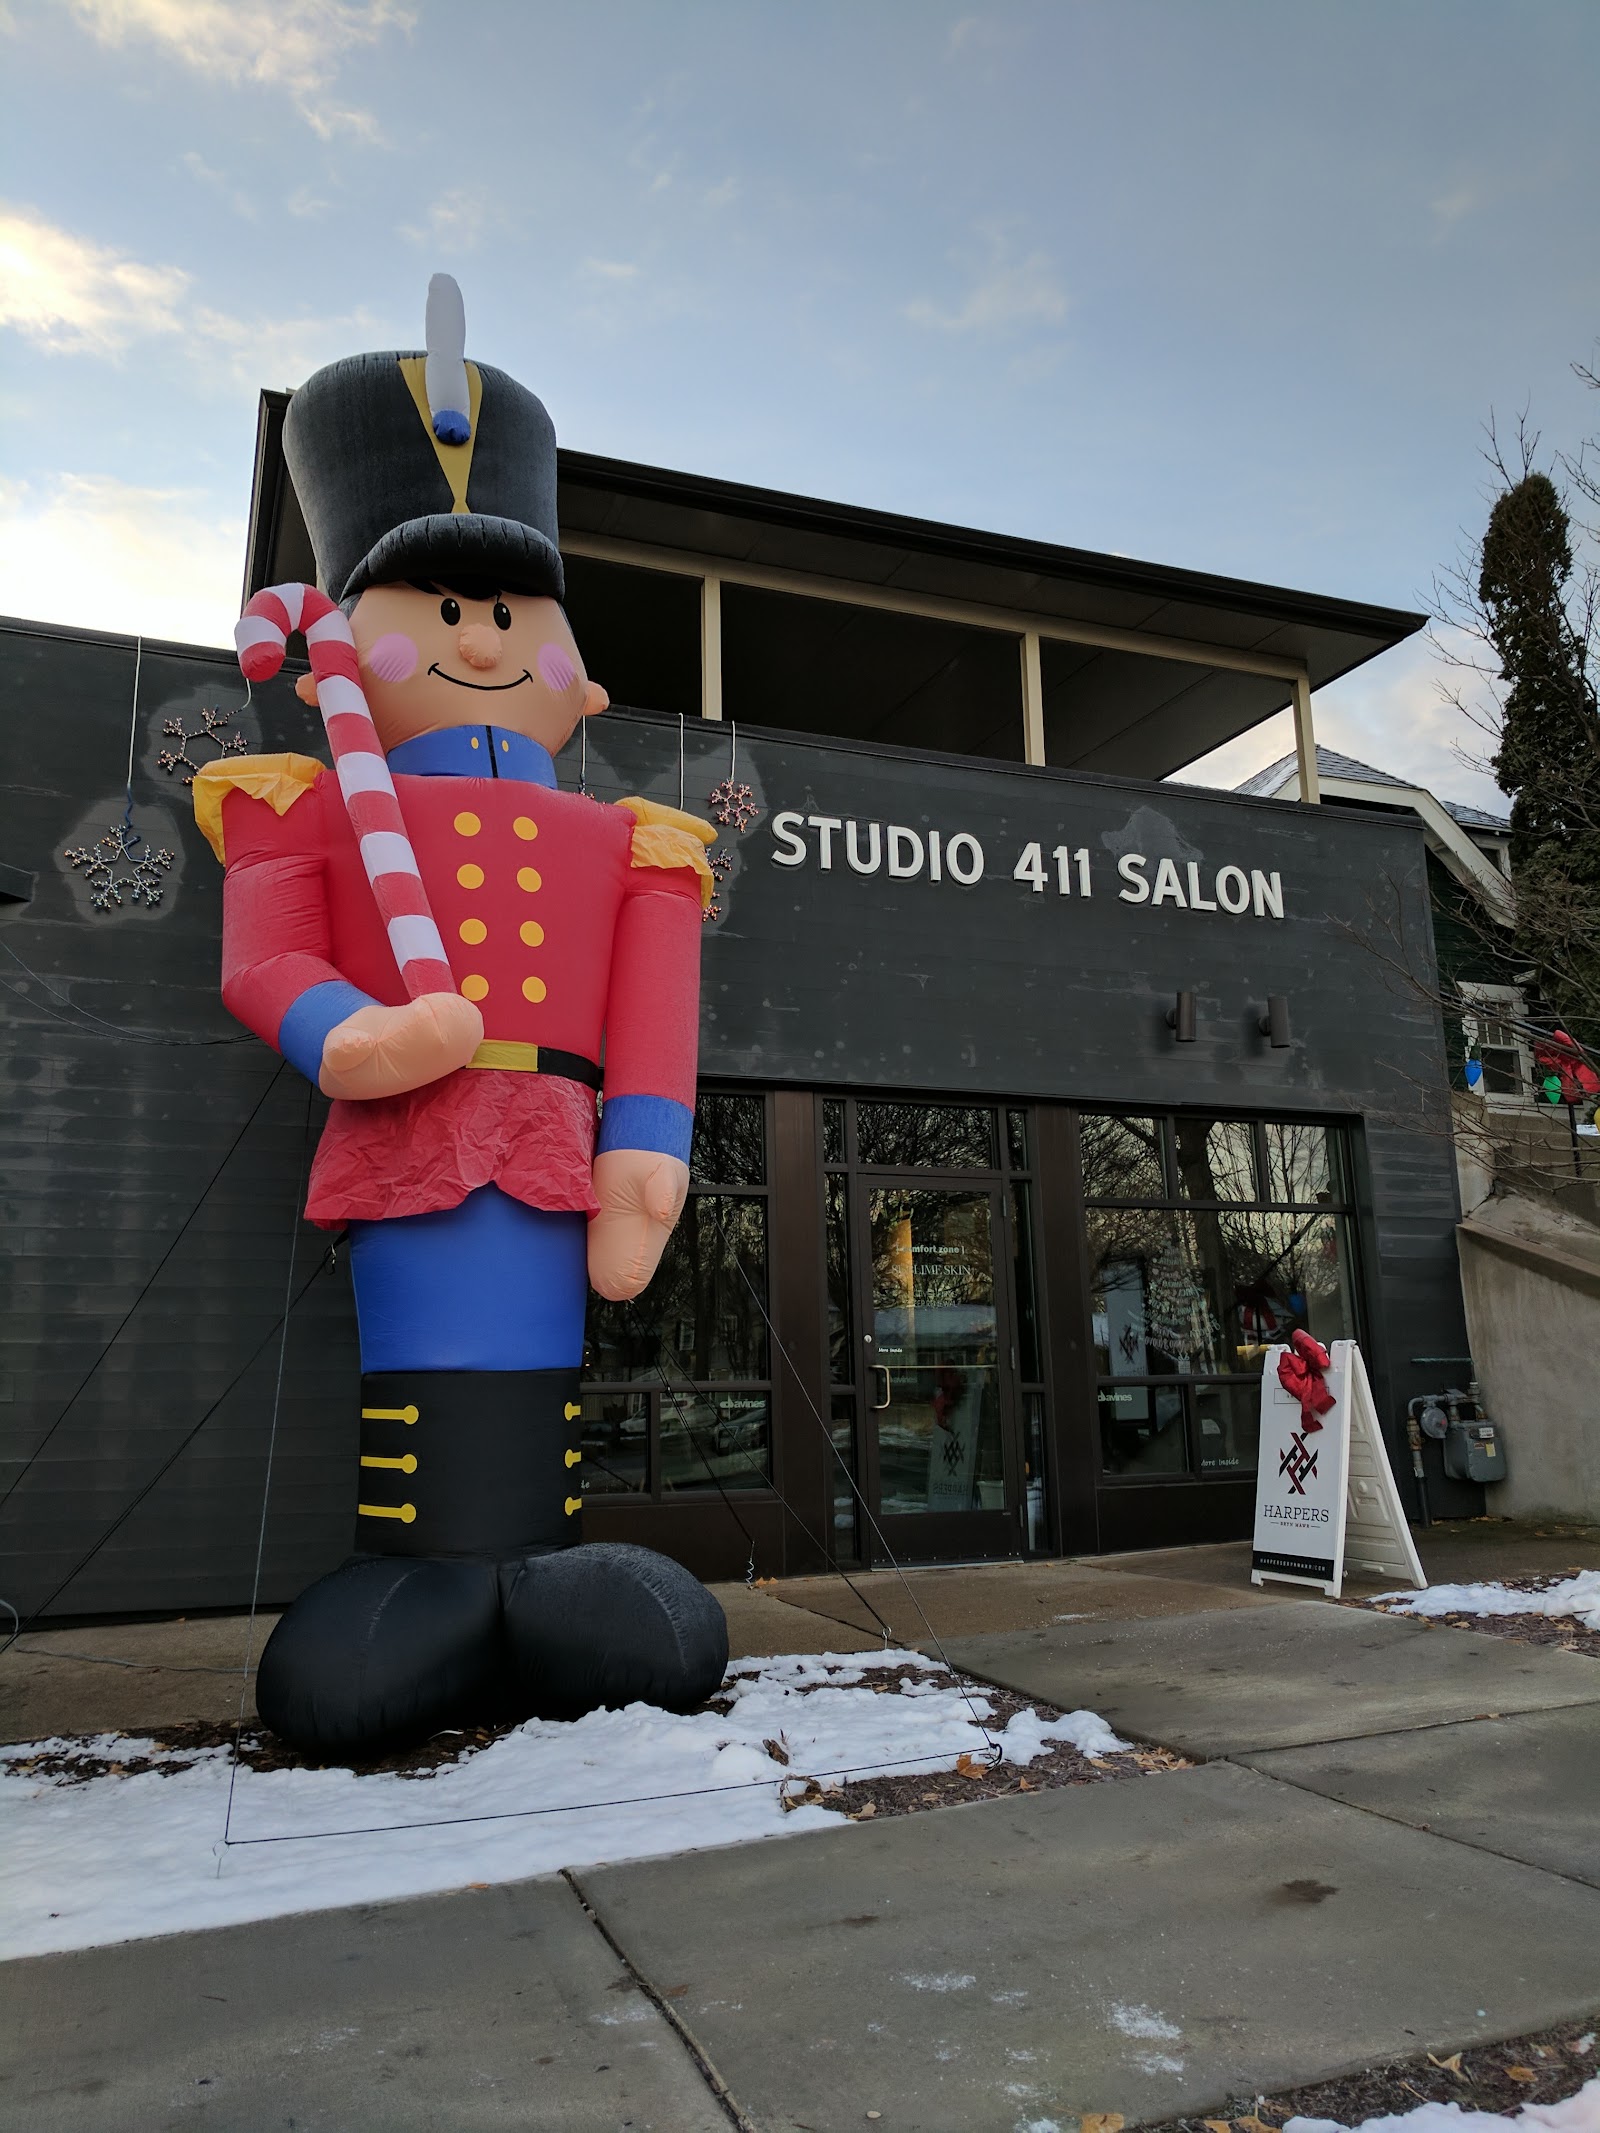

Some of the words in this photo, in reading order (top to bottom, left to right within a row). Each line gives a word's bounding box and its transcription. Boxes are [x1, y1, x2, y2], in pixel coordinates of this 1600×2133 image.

[771, 811, 985, 885] STUDIO
[1013, 842, 1092, 898] 411
[1117, 853, 1284, 919] SALON
[900, 1244, 937, 1253] mfort
[891, 1264, 942, 1275] SLIME
[943, 1264, 971, 1275] SKIN
[1263, 1504, 1330, 1523] HARPERS
